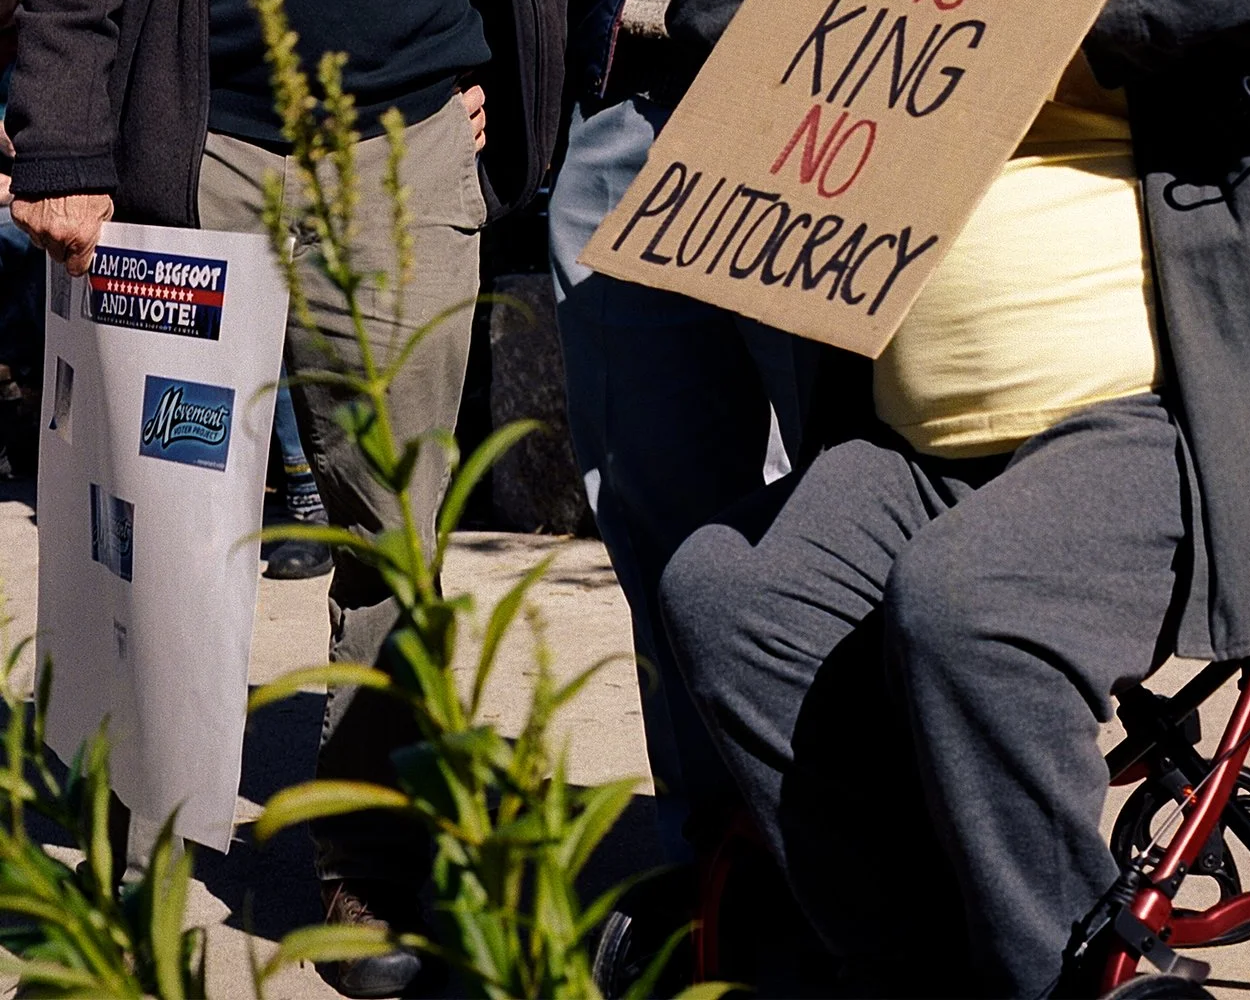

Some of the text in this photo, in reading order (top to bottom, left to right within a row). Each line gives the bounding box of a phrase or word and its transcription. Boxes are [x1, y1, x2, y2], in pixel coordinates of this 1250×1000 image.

[770, 104, 877, 198] NO
[611, 161, 938, 316] PLUTOCRACY
[98, 253, 119, 278] AM
[100, 293, 198, 327] AND I VOTE!
[143, 387, 229, 447] Movement
[192, 425, 218, 441] PROJECT
